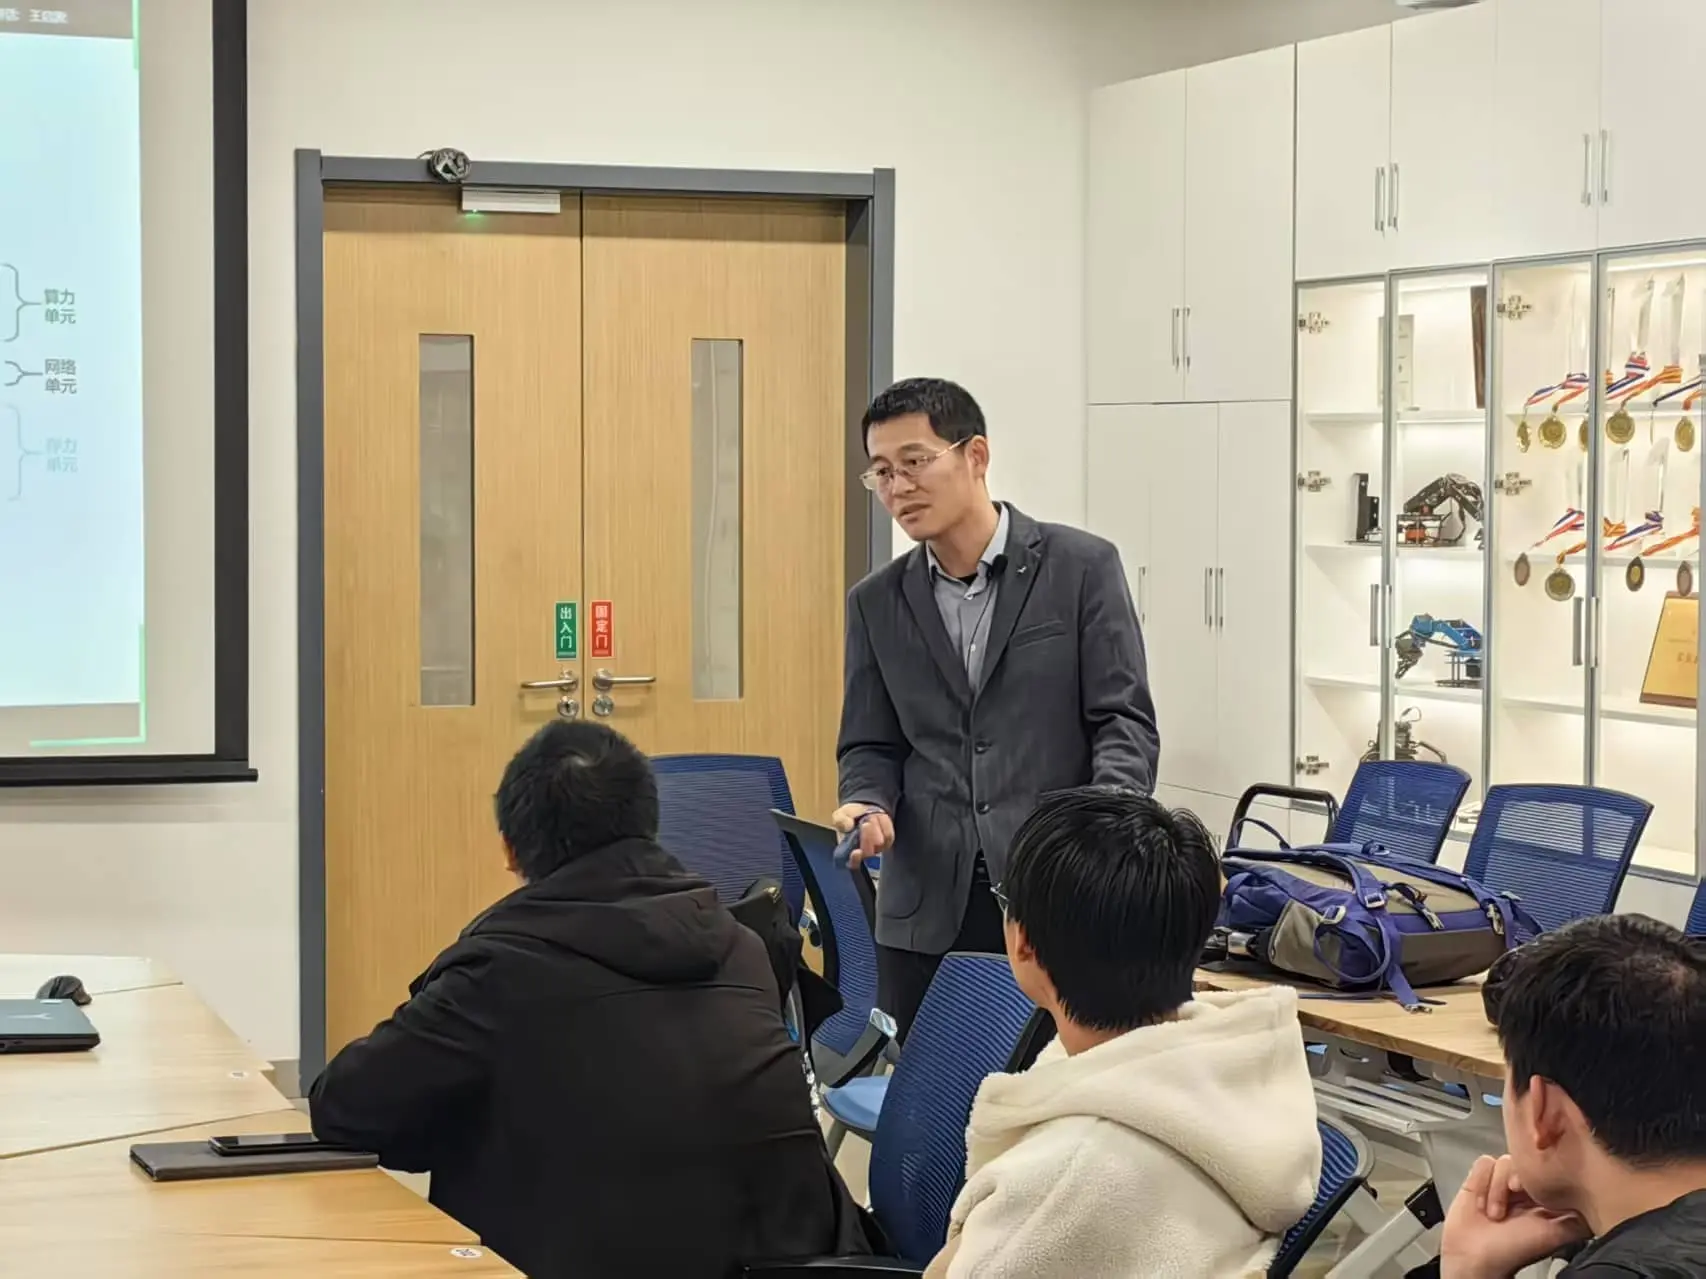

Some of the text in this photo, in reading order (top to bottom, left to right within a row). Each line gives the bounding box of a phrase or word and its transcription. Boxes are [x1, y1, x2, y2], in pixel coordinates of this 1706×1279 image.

[44, 308, 76, 324] 单元
[44, 358, 77, 375] 网络
[44, 377, 77, 394] 单元
[560, 605, 573, 649] 出入门
